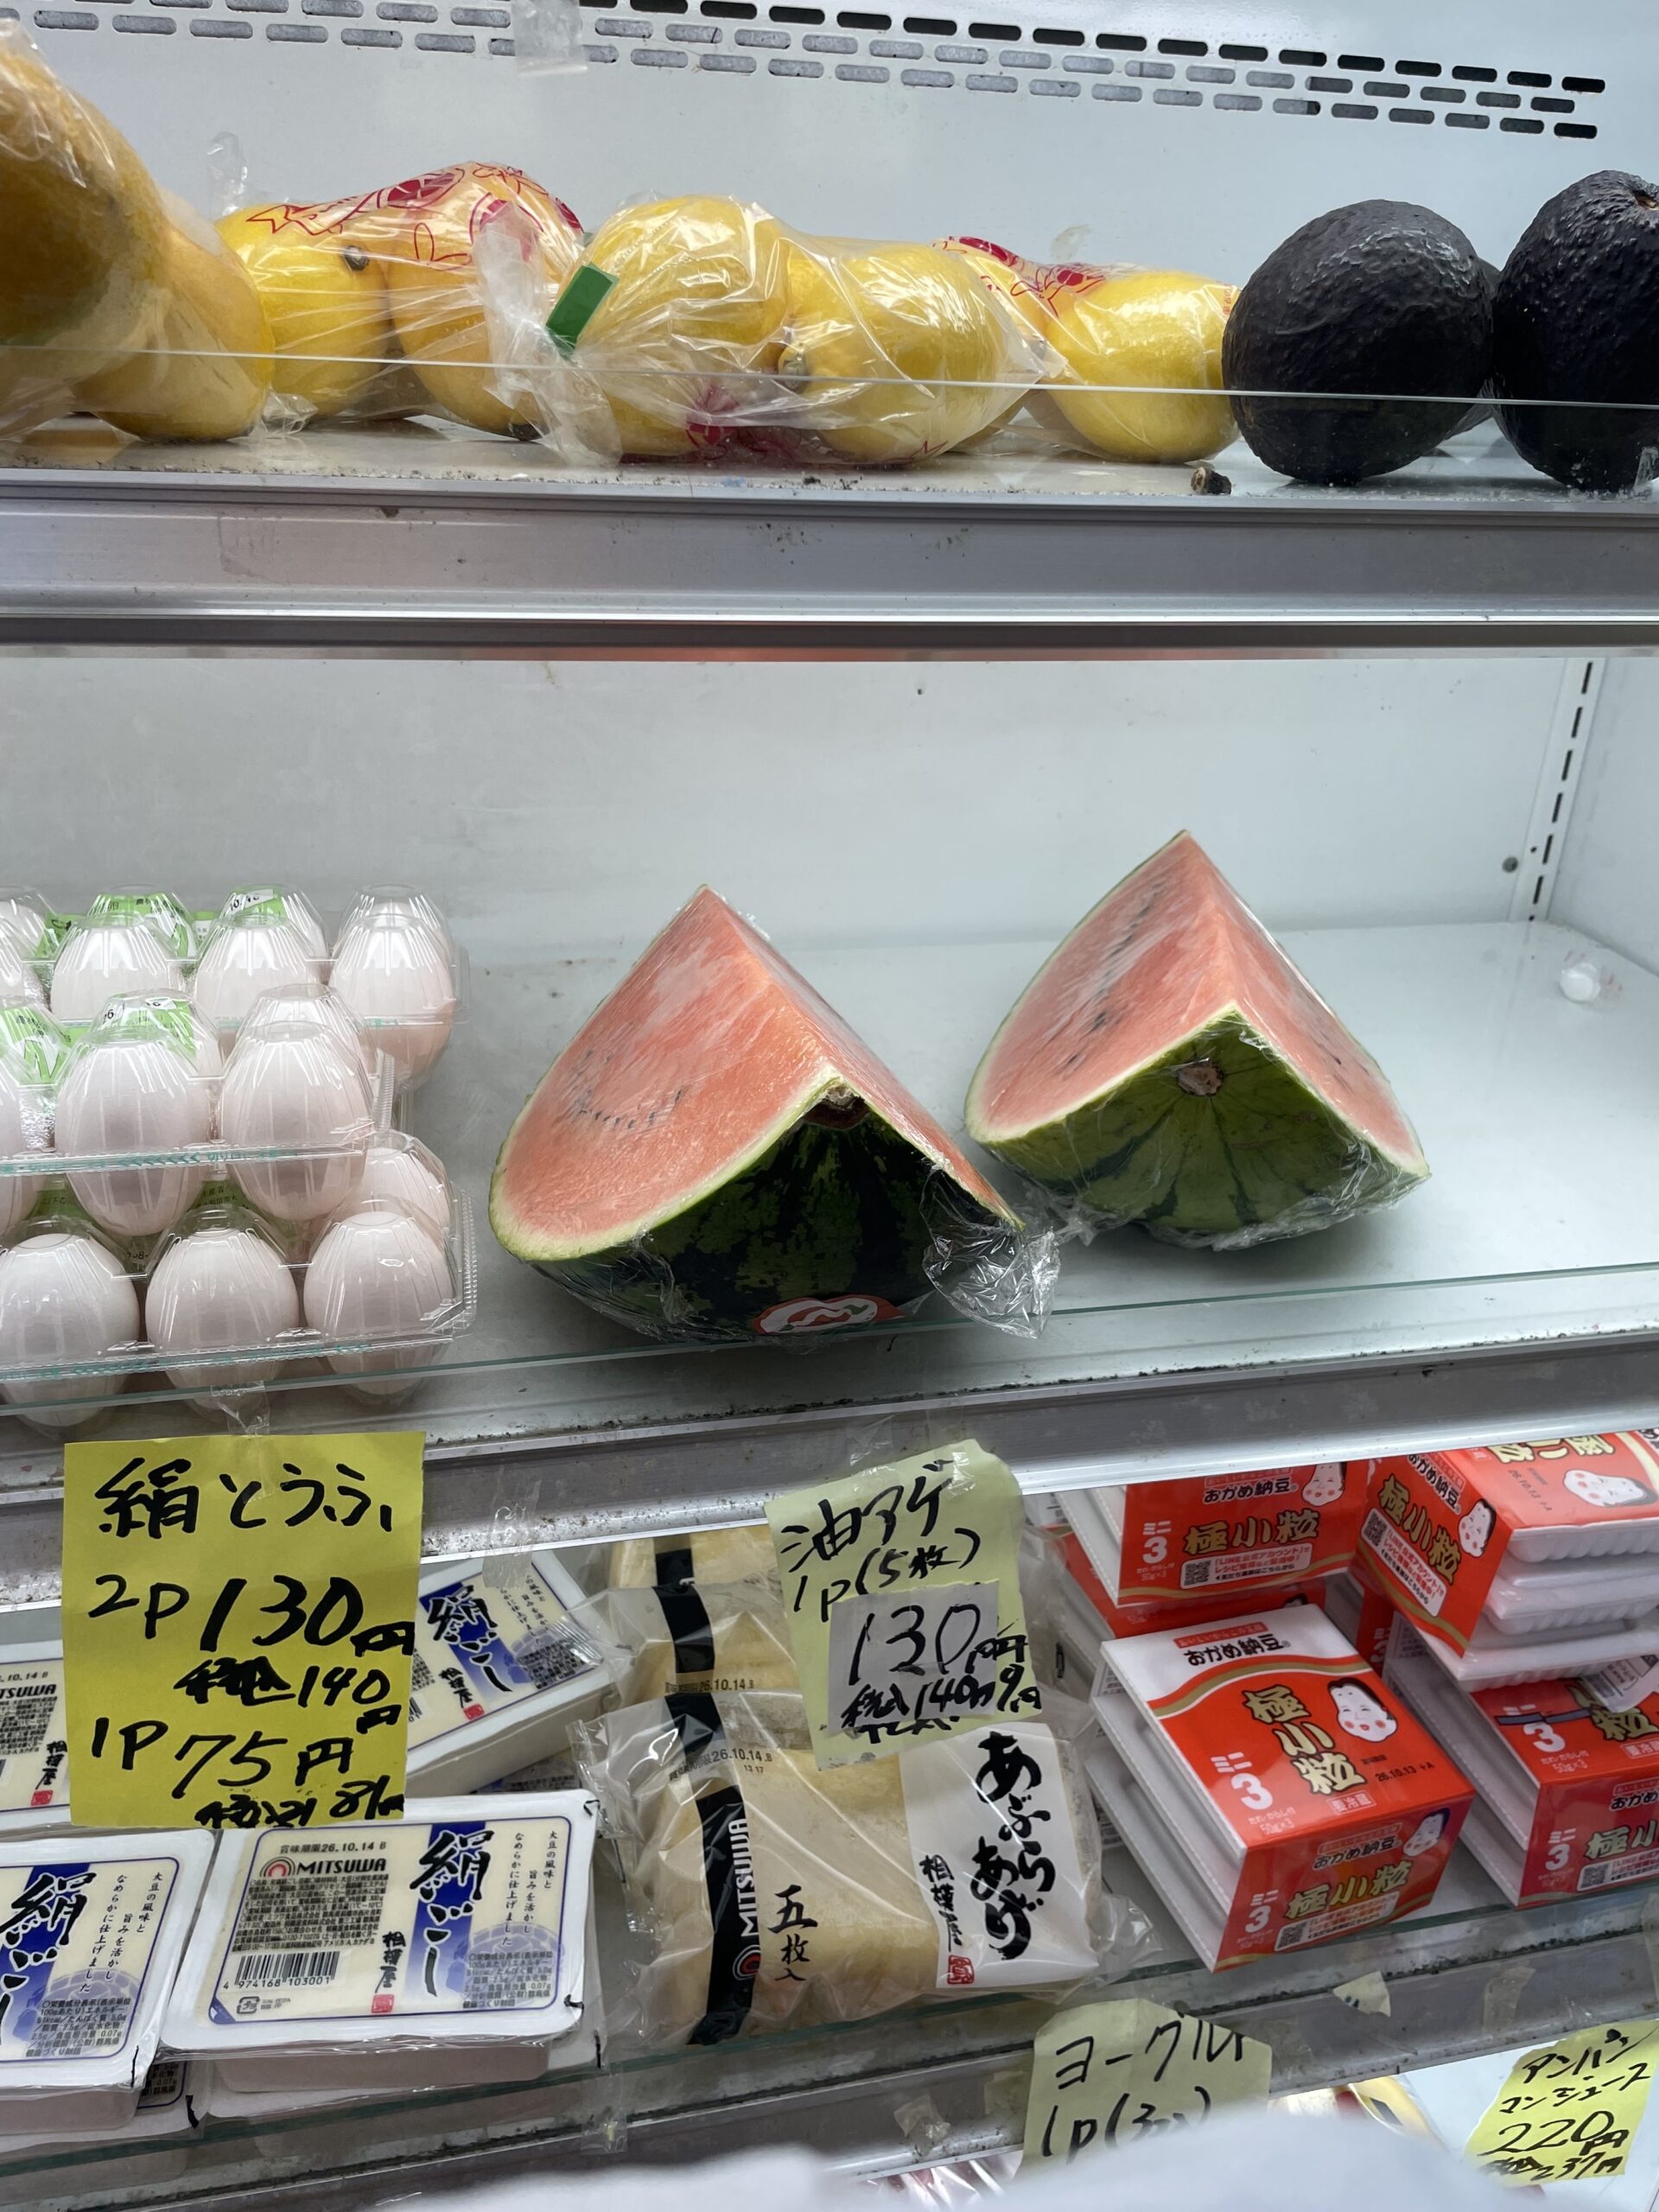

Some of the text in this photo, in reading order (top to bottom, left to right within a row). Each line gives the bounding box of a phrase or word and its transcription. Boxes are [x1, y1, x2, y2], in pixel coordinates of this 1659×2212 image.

[94, 1457, 392, 1539] 絹とうふ
[1204, 1477, 1290, 1503] おかめ納豆
[1142, 1536, 1167, 1564] 3
[1183, 1510, 1319, 1556] 極小粒
[1378, 1473, 1461, 1585] 極小粒
[1184, 1634, 1285, 1666] おかめ納豆
[1242, 1684, 1367, 1796] 極小粒
[1523, 1722, 1566, 1752] 3
[172, 1731, 353, 1799] 75円
[1230, 1773, 1274, 1810] 3
[297, 1859, 387, 1875] MITSUWA
[543, 1830, 559, 1890] 大豆の風味と
[1313, 1835, 1396, 1869] おかめ納豆
[1546, 1844, 1570, 1871] 3
[728, 1819, 760, 1937] MITSUWA
[1285, 1860, 1413, 1920] 極小粒
[137, 1872, 163, 1933] 大豆の風味と
[410, 1830, 495, 1999] 絹ごし
[1245, 1906, 1271, 1933] 3
[767, 1884, 818, 1981] 五枚入
[238, 1978, 281, 1989] 974168
[289, 1976, 330, 1986] 103001
